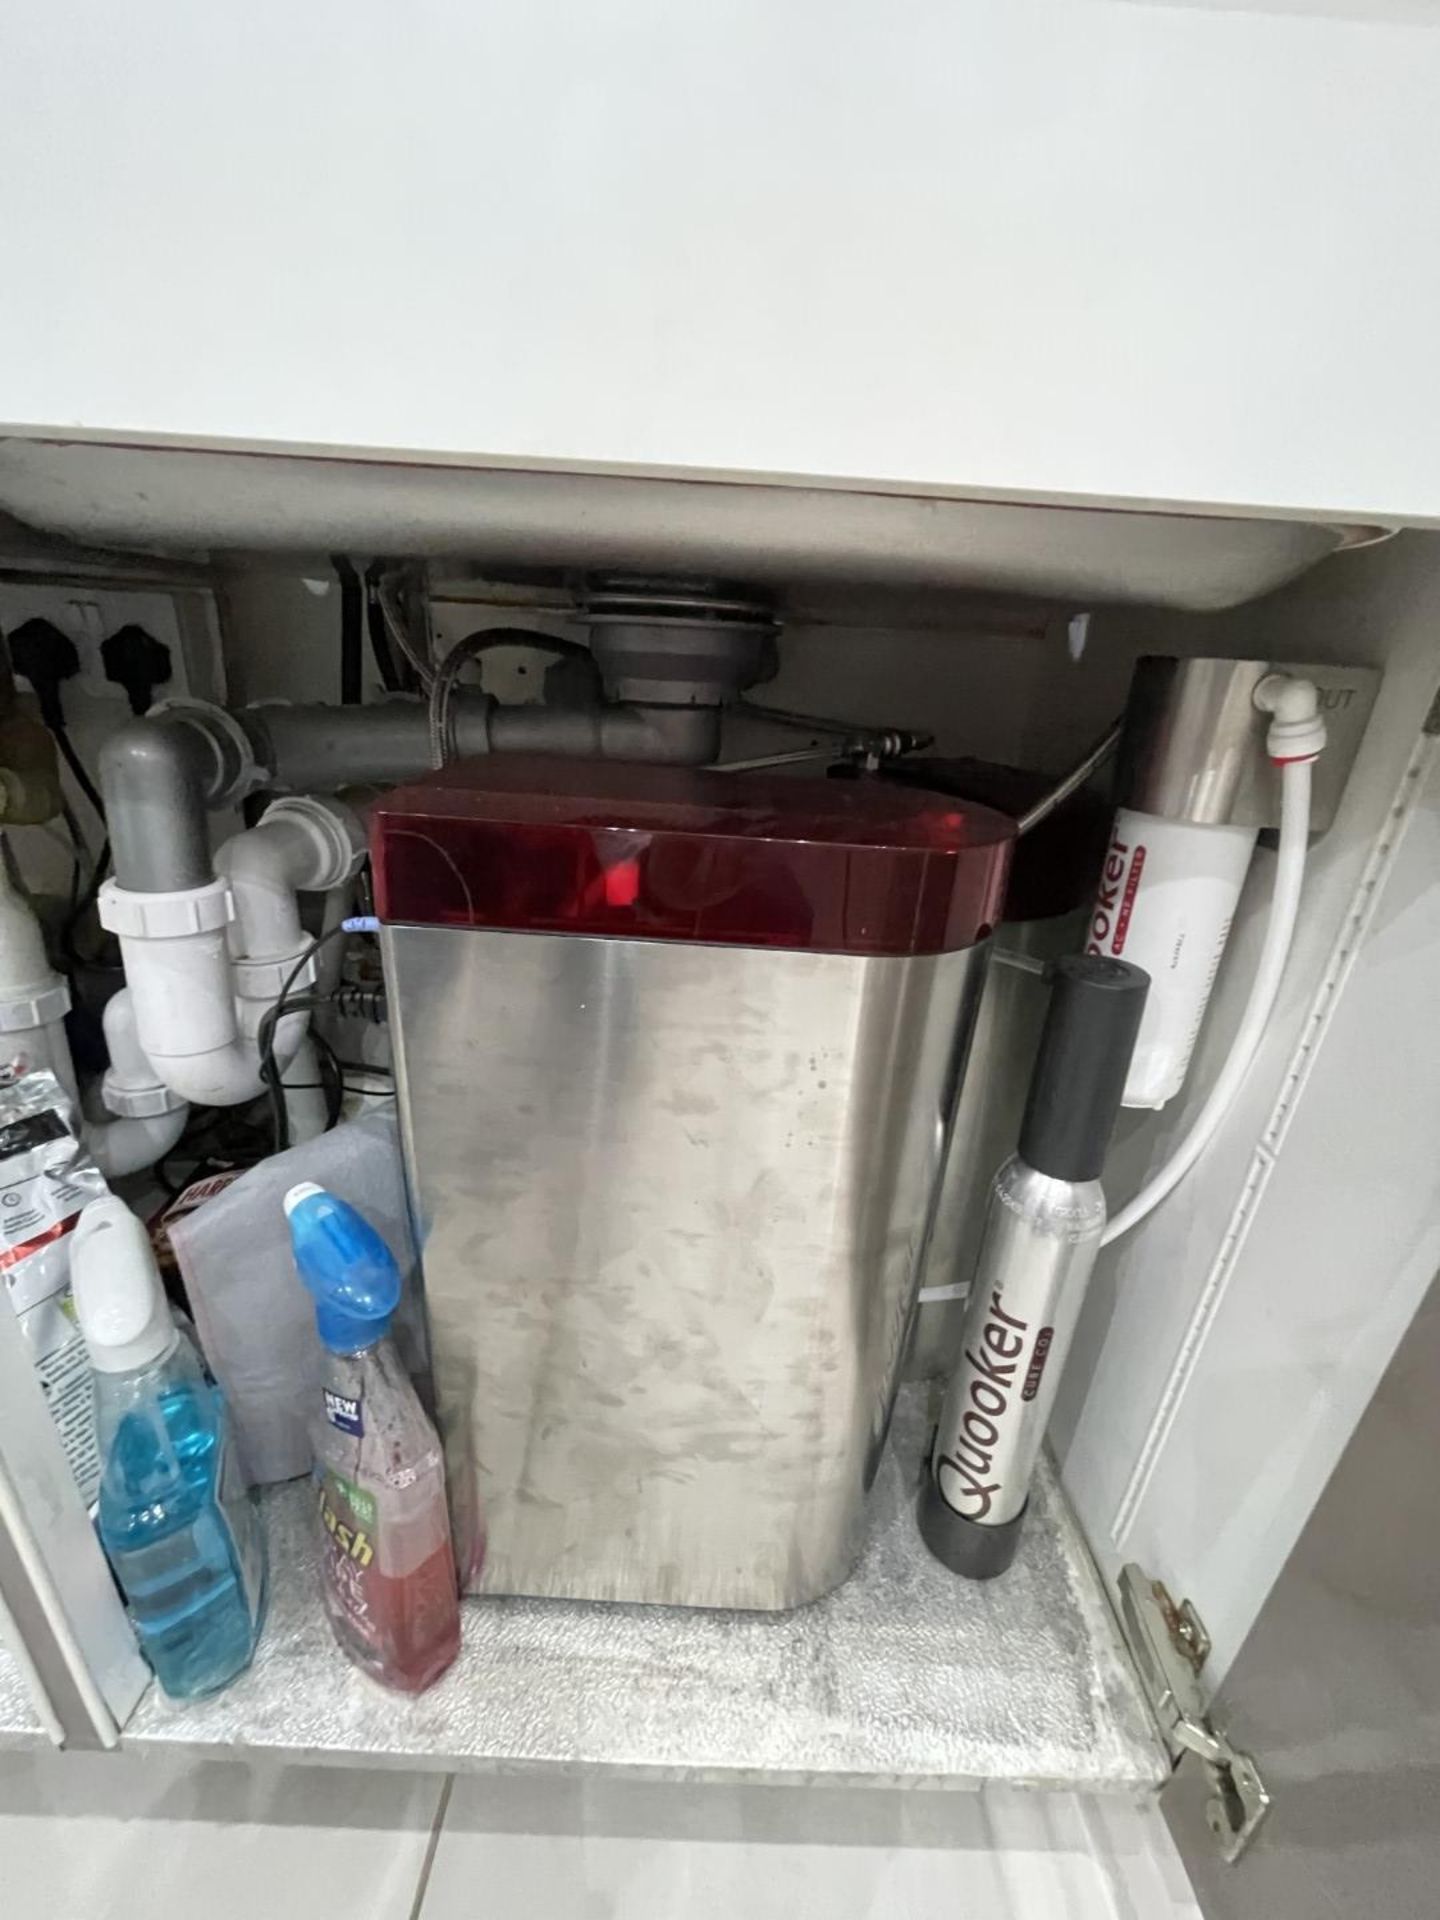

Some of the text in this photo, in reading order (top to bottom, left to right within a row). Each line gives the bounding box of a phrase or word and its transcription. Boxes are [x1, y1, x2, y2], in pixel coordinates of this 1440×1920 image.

[1023, 1364, 1041, 1397] CUBE
[325, 1391, 357, 1415] NEW
[937, 1290, 1028, 1522] Quooker
